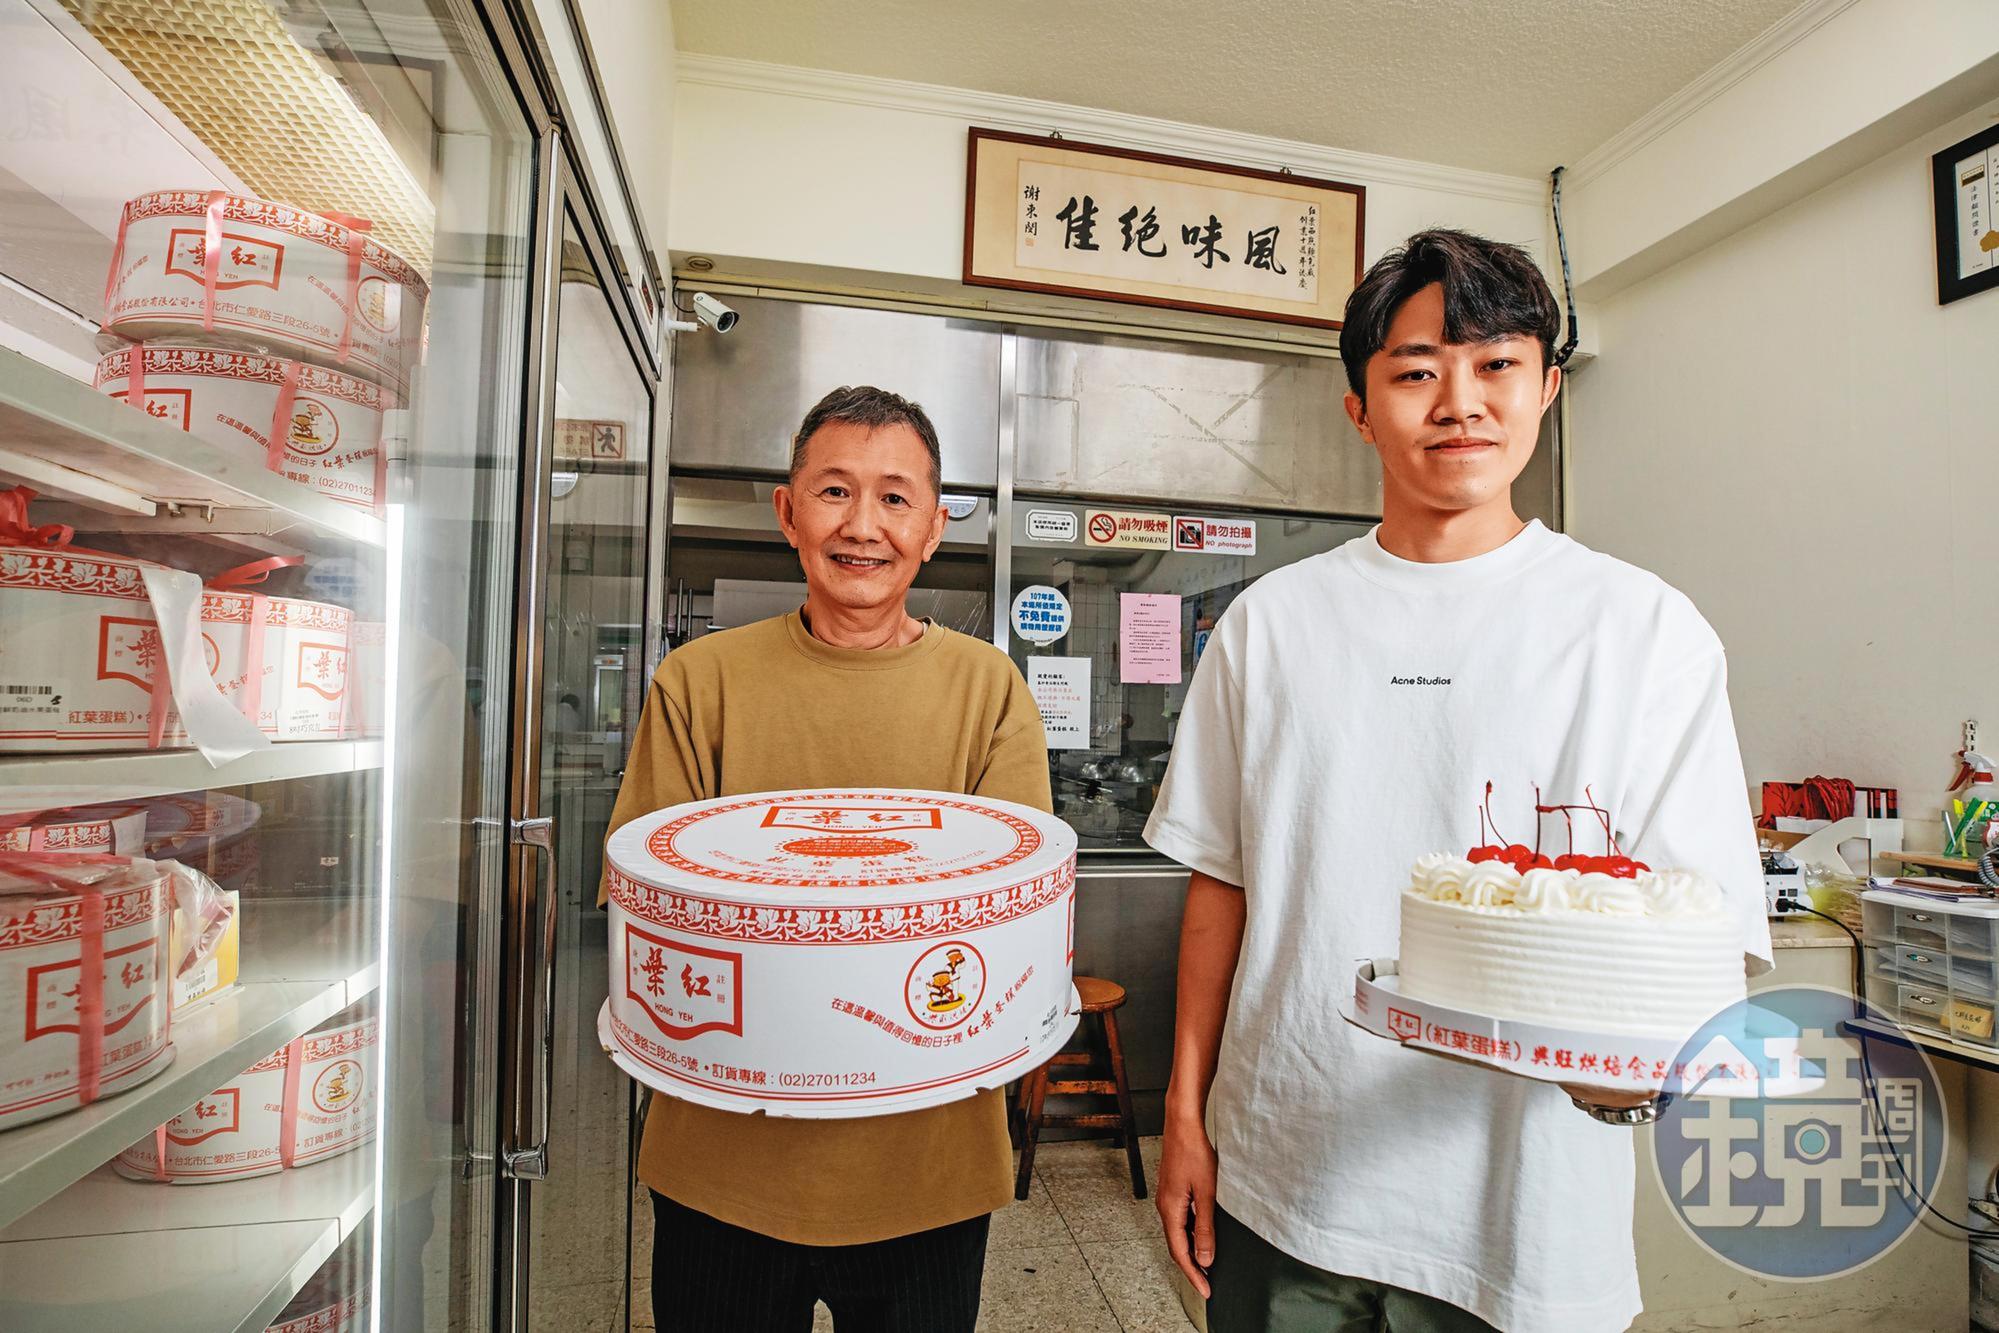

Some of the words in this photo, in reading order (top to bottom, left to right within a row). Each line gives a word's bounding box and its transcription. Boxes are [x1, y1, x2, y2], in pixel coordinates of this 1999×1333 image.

[1118, 517, 1169, 534] 請勿吸煙
[1206, 525, 1252, 539] 請勿拍攝
[1133, 536, 1168, 544] SMOKING
[1391, 676, 1415, 685] Acne
[1416, 676, 1451, 685] Studios
[640, 946, 711, 998] 紅葉
[655, 1002, 673, 1016] HONG
[678, 1011, 694, 1022] YEH
[779, 1071, 876, 1087] (02)27011234
